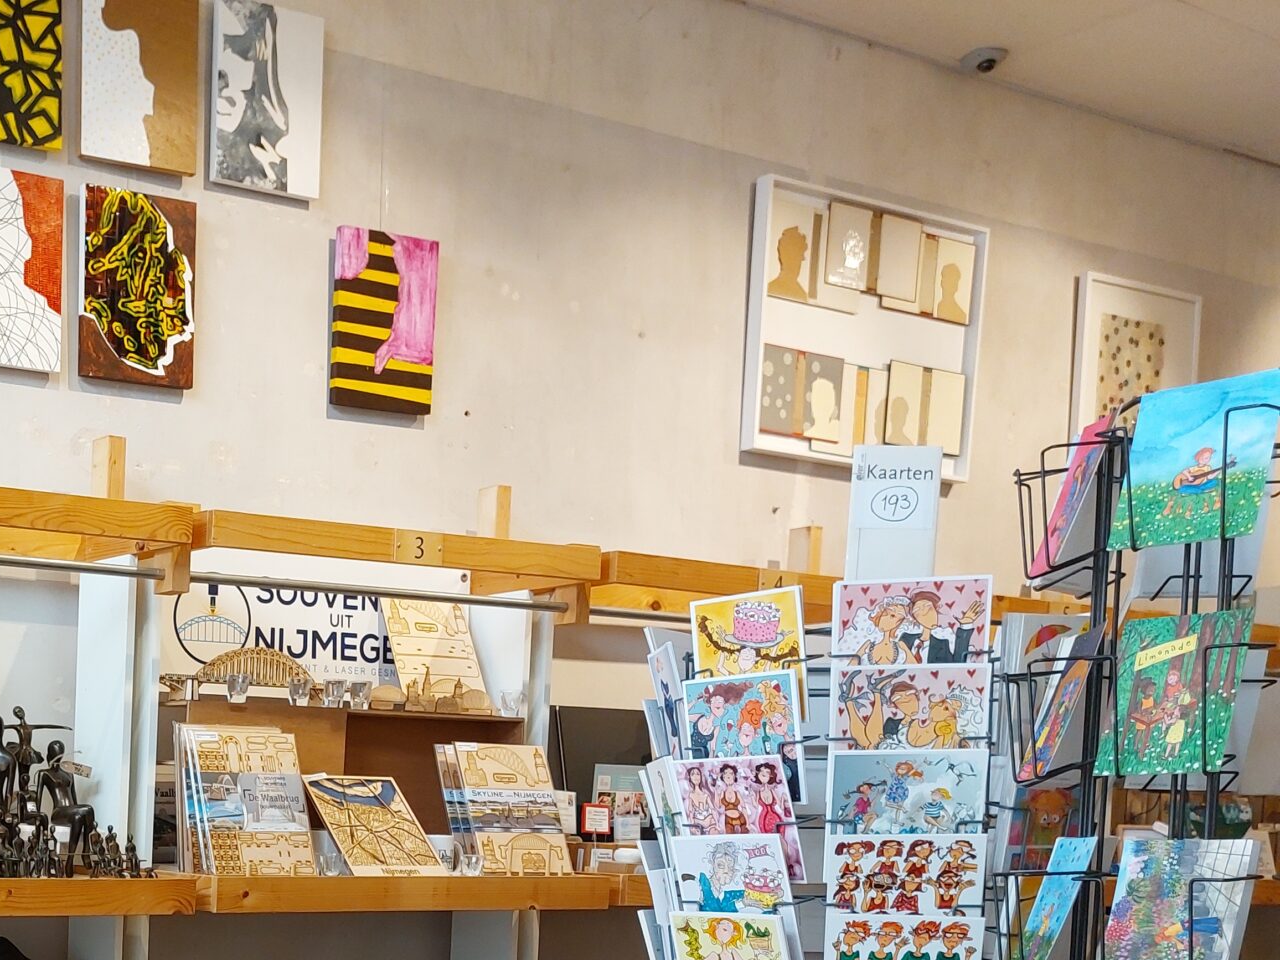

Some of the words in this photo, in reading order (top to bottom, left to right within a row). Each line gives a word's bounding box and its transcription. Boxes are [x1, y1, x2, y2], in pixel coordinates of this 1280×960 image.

[867, 463, 934, 480] Kaarten
[881, 494, 911, 517] 193
[414, 536, 424, 559] 3
[256, 588, 382, 612] SOUVEN
[329, 613, 354, 629] UIT
[254, 626, 396, 665] NIJMEGE
[1138, 640, 1192, 666] Limonade
[335, 665, 366, 675] LASER
[370, 668, 396, 678] GESN
[260, 793, 300, 805] Waalbrug
[471, 789, 505, 798] SKYLINE
[513, 791, 553, 799] NIJMEGEN
